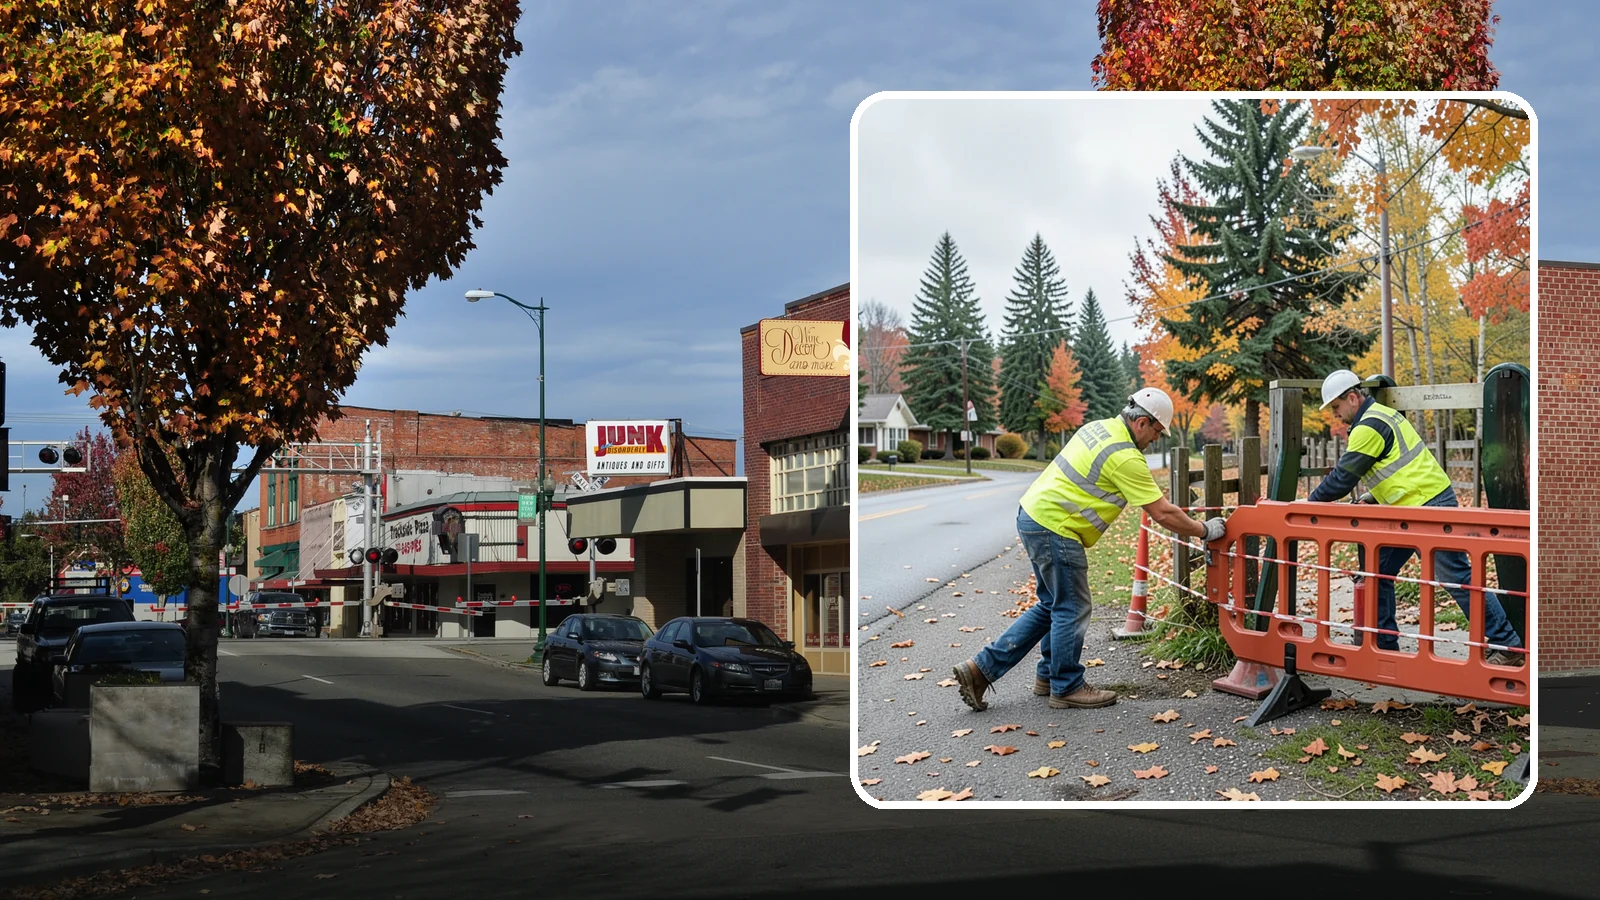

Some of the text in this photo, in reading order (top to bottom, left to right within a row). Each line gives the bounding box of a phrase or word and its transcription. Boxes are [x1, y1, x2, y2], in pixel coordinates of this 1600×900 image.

[595, 425, 665, 457] JUNK
[607, 446, 646, 455] DISORDERLY
[596, 460, 665, 470] ANTIQUES AND GIFTS
[414, 519, 429, 535] Pizza
